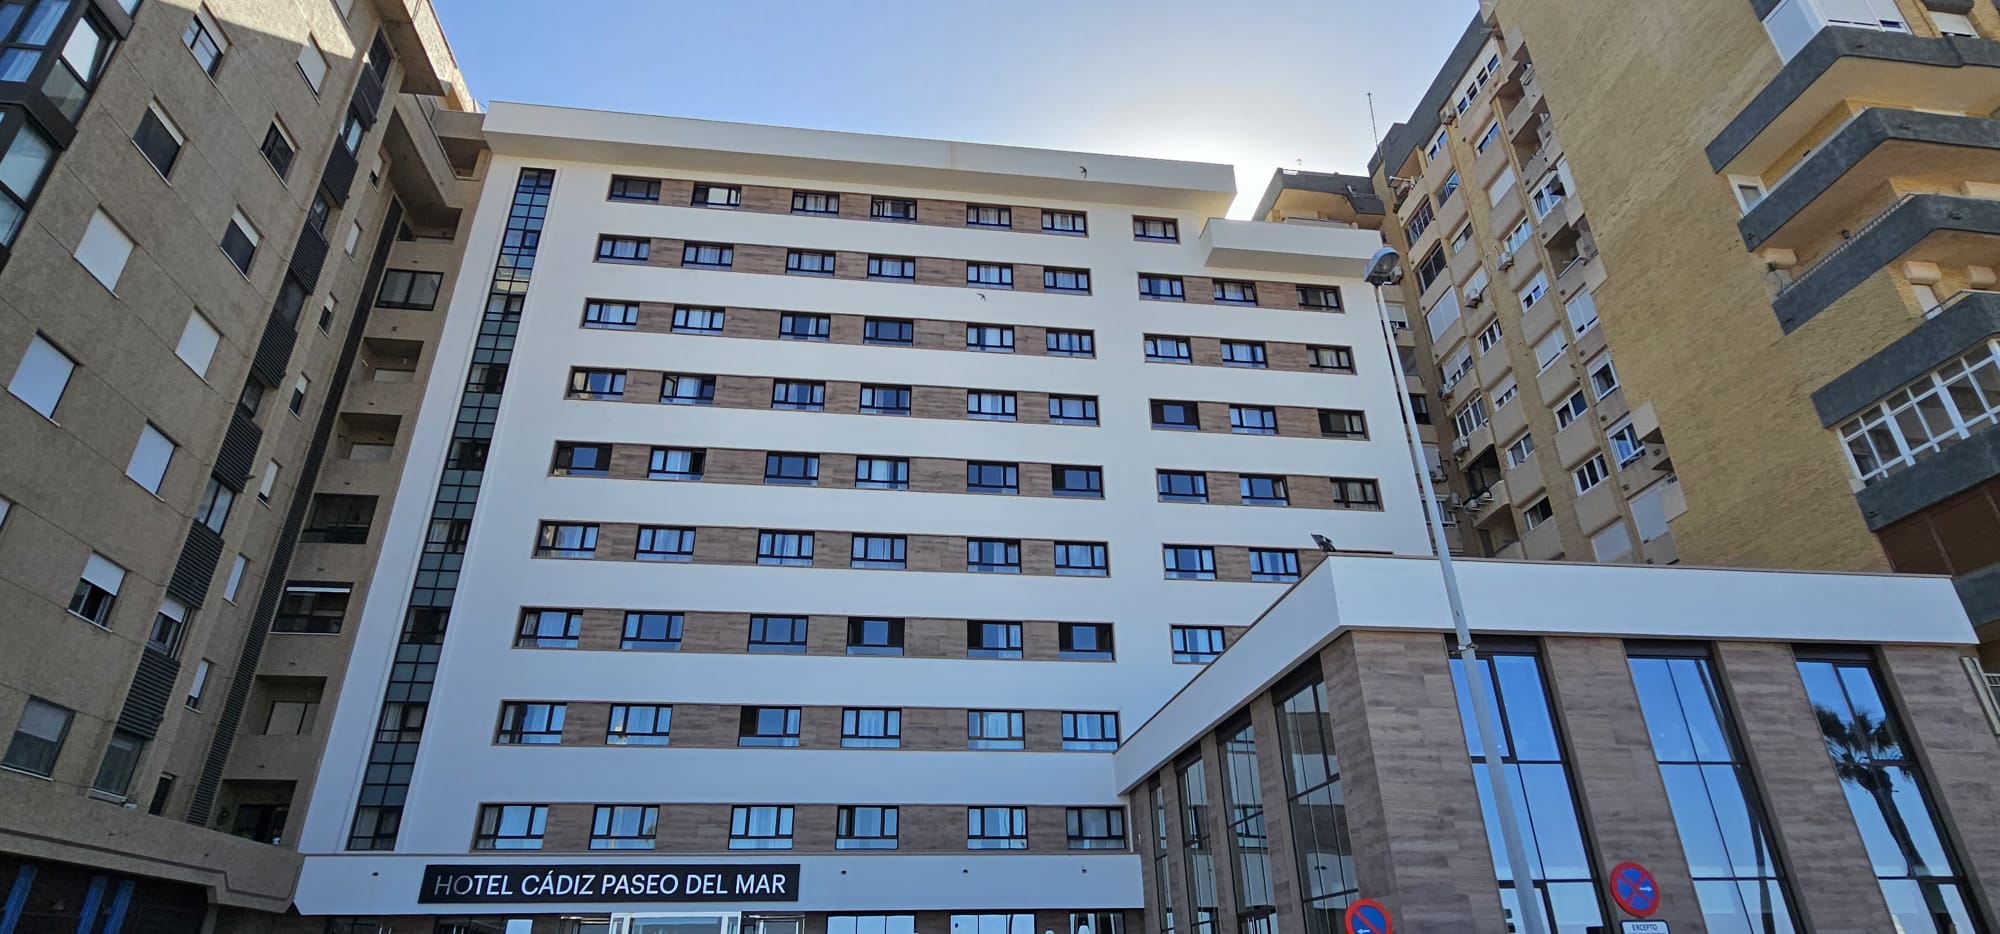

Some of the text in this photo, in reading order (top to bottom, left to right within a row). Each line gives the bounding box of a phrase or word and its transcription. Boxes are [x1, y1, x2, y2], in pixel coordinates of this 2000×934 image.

[433, 869, 786, 896] HOTEL CÁDIZ PASEO DEL MAR
